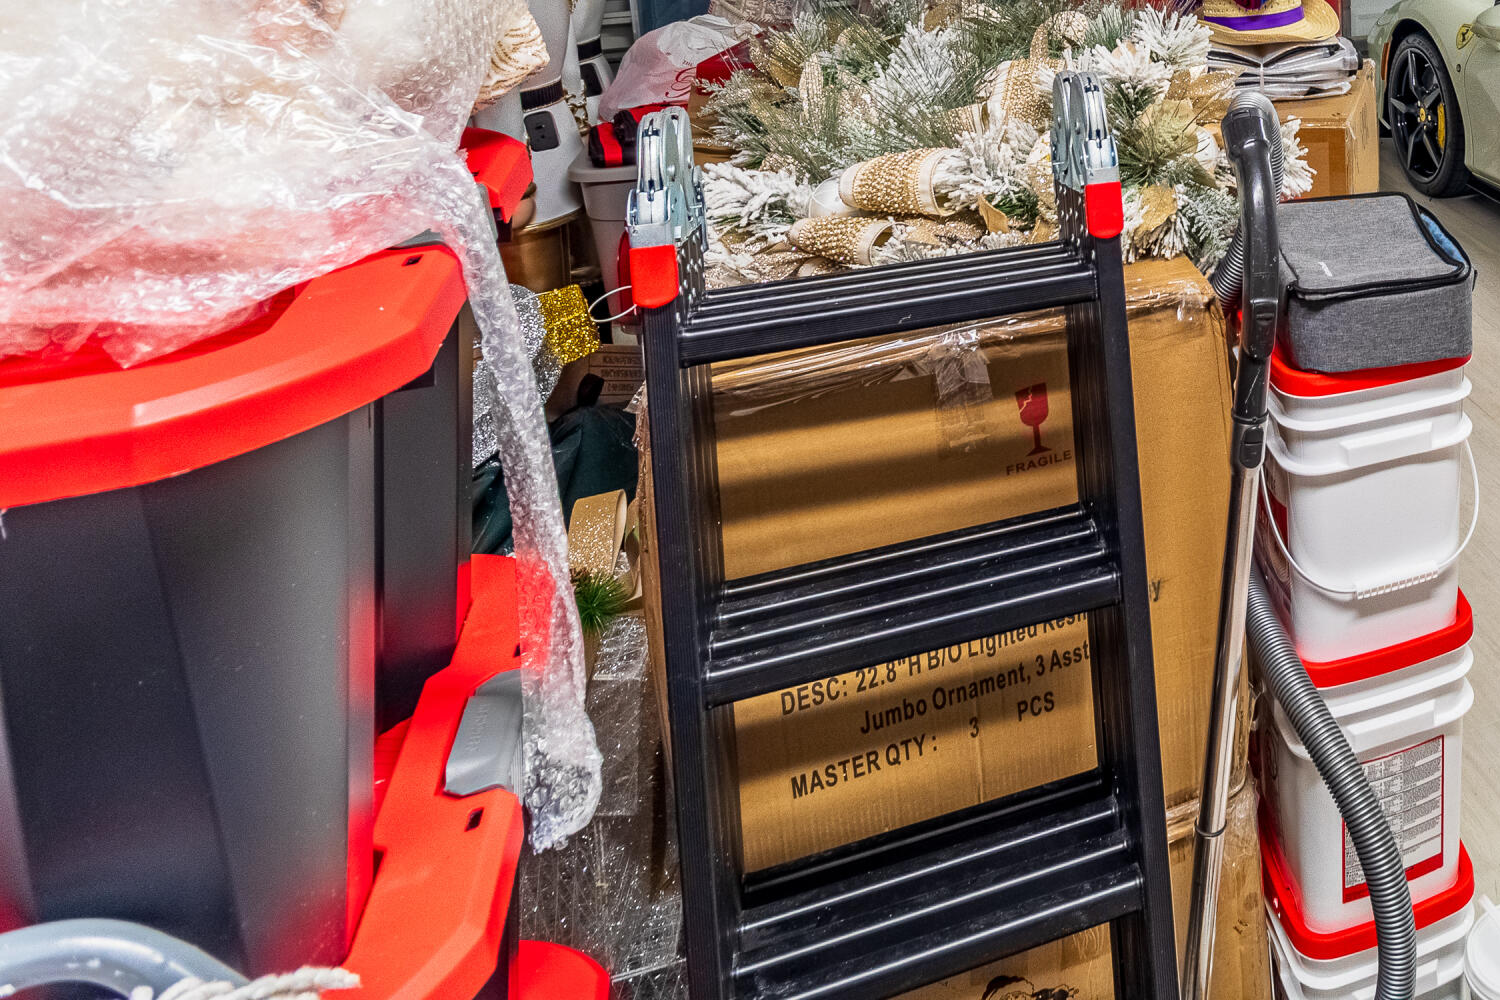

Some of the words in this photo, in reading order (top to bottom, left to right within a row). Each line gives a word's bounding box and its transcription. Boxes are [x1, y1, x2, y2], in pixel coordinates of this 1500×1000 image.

[1005, 449, 1073, 476] FRAGILE
[781, 677, 848, 716] DESC:
[926, 647, 962, 671] B/O
[860, 697, 928, 735] Jumbo
[932, 662, 1032, 711] Ornament,
[1035, 654, 1046, 677] 3
[1049, 640, 1090, 673] Asst
[791, 750, 881, 800] MASTER
[885, 733, 926, 767] QTY
[969, 716, 980, 739] 3
[1016, 691, 1056, 722] PCS
